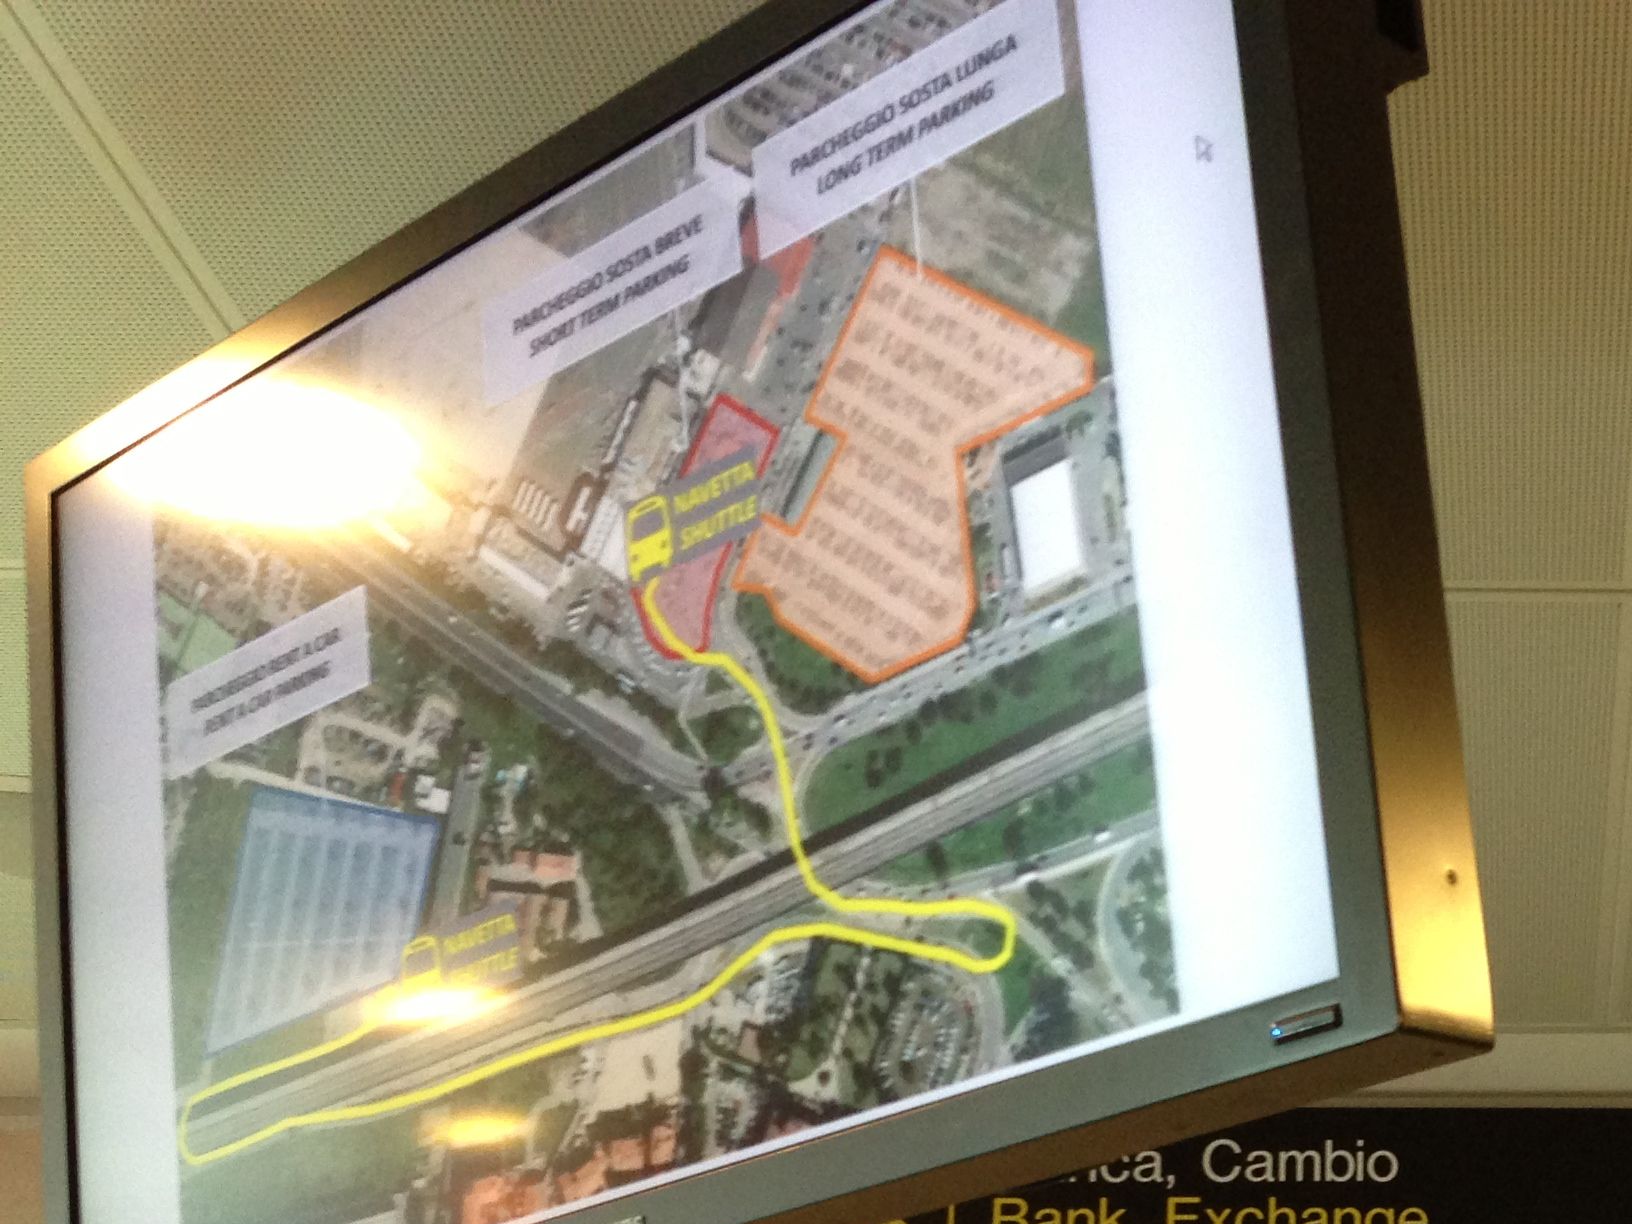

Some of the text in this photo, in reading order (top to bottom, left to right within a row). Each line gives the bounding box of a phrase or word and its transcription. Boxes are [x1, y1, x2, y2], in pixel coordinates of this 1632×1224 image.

[790, 34, 1018, 176] PARCHEGGIO SOSTA LUNGA
[817, 81, 995, 195] LONG TERM PARKING
[513, 214, 703, 335] PARCHEGGIO SOSTA BREVE
[530, 254, 690, 357] SHORT TERM PARKING
[673, 461, 756, 513] NAVETTA
[681, 495, 757, 550] SHUTTLE
[1201, 1139, 1399, 1190] Cambio
